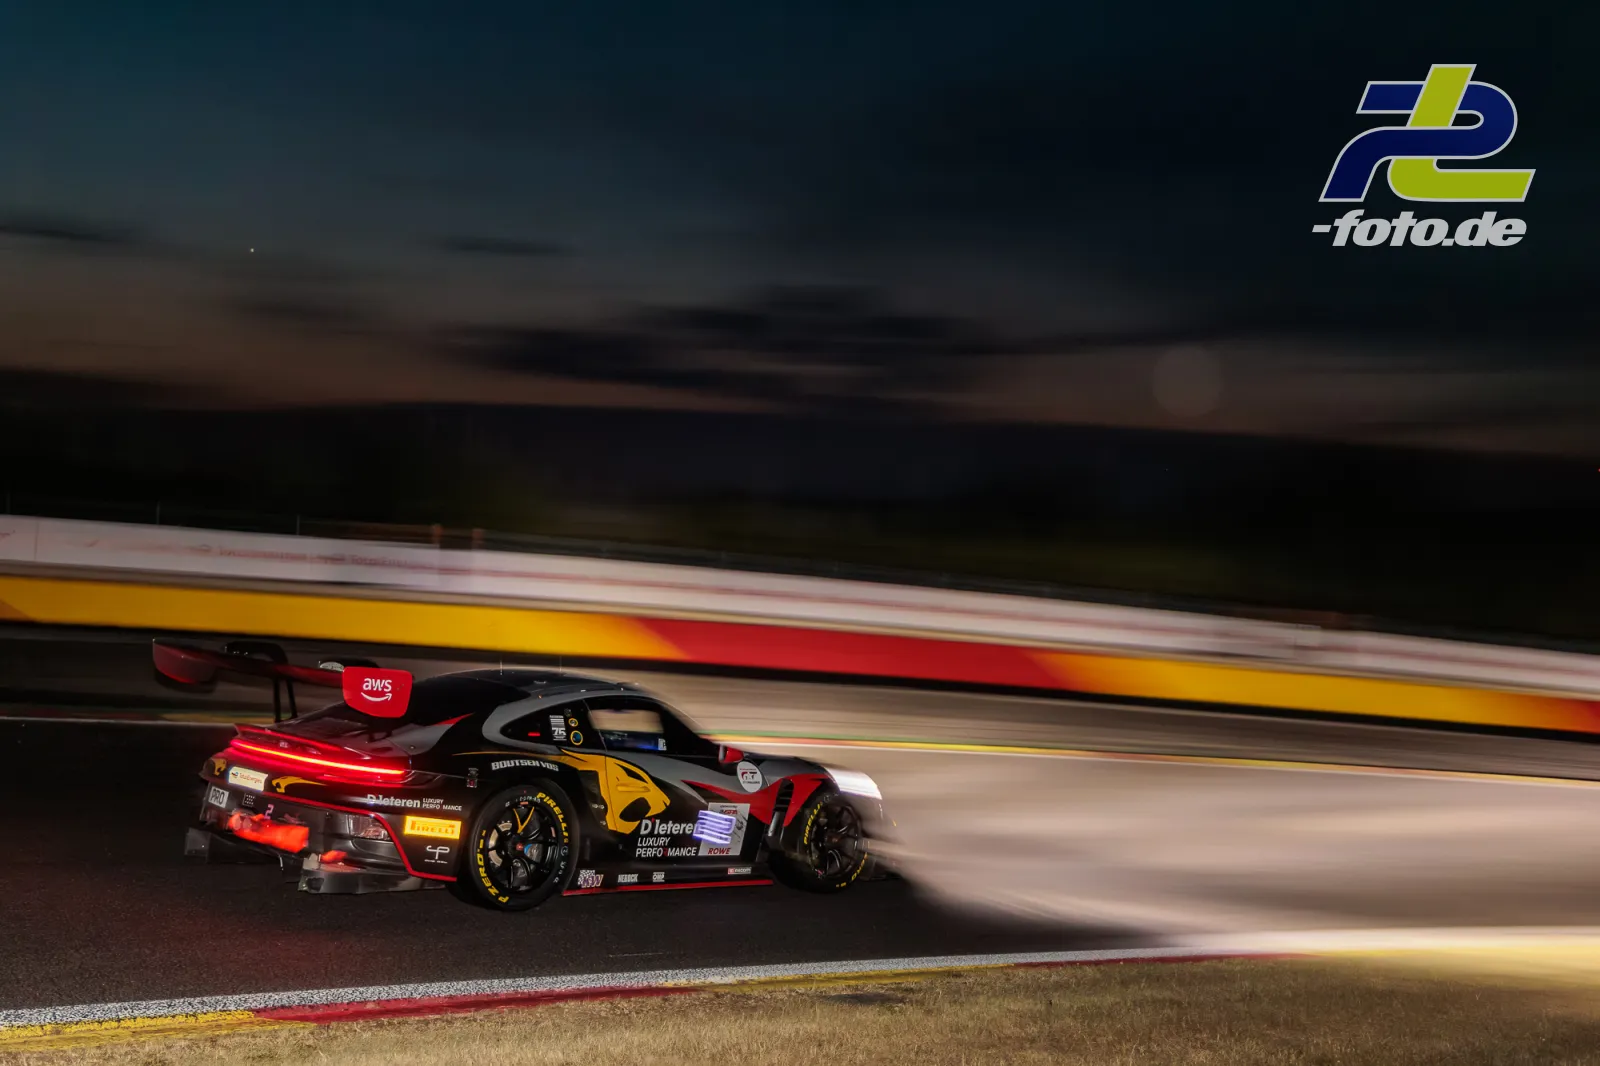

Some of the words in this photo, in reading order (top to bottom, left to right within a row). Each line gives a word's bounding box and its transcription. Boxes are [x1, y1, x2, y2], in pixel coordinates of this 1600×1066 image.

[362, 677, 393, 692] aws
[491, 759, 540, 771] BOUTSEN
[209, 787, 226, 806] PRO
[422, 797, 444, 805] LUXURY
[422, 803, 463, 812] PERFOMANCE
[537, 792, 569, 838] PIRELLI
[637, 836, 671, 848] LUXURY
[707, 847, 732, 856] ROWE
